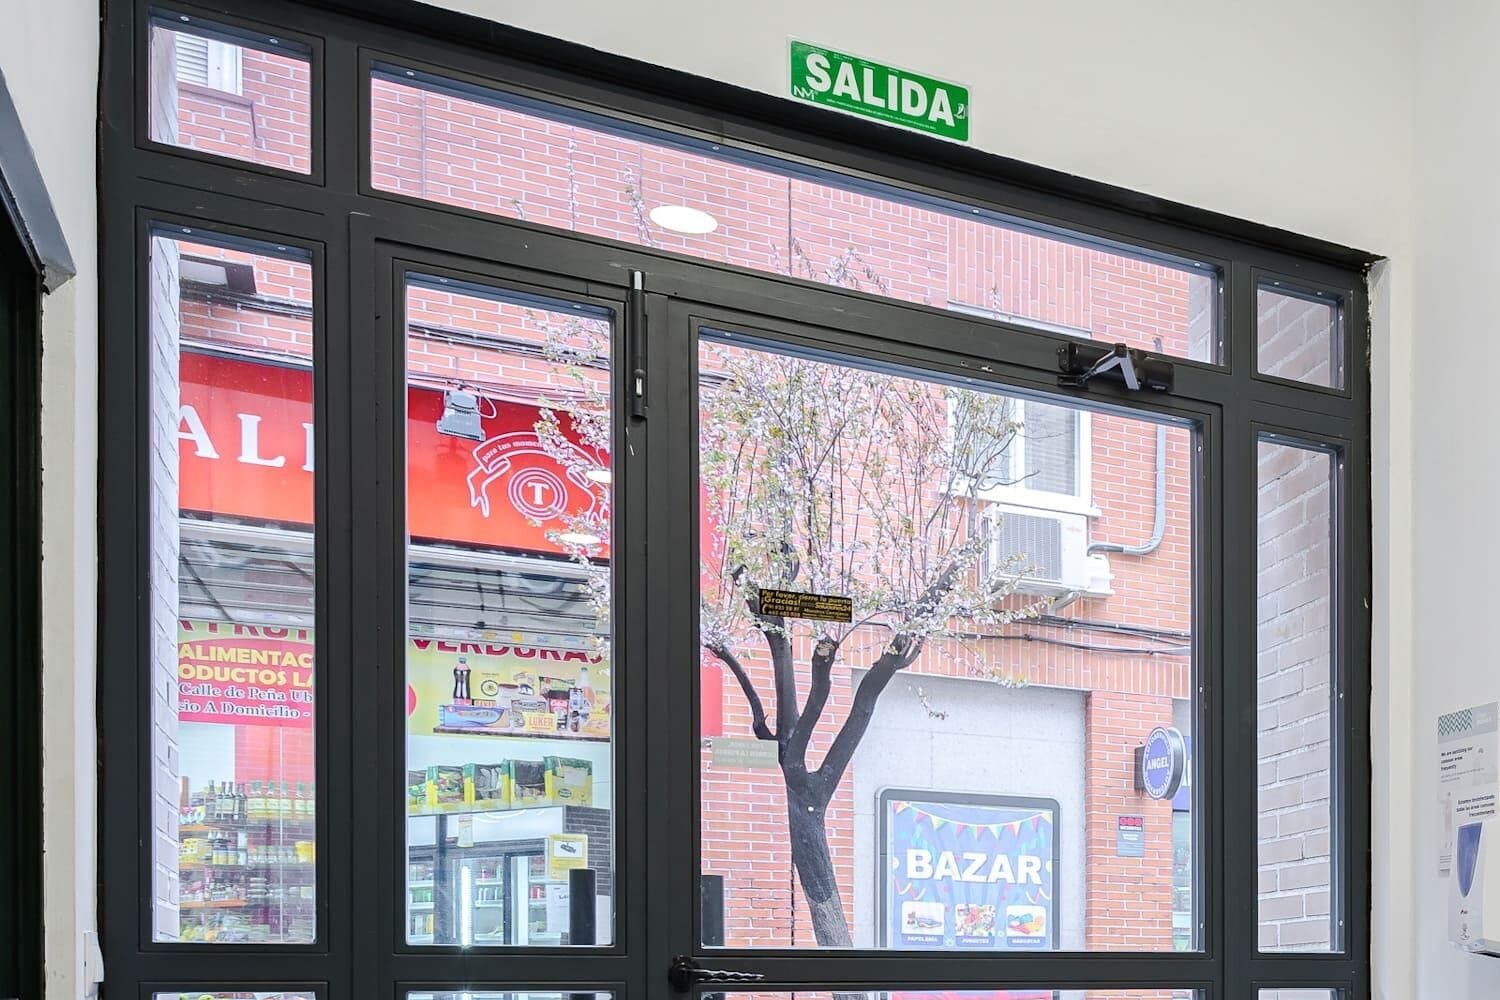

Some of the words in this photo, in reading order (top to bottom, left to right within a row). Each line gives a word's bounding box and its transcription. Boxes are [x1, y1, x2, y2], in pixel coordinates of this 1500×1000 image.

[805, 52, 956, 127] SALIDA
[527, 481, 550, 505] T
[179, 682, 222, 697] Calle
[225, 685, 244, 699] de
[250, 687, 286, 701] Peña
[203, 701, 218, 713] A
[222, 702, 300, 718] Domicilio
[1146, 756, 1169, 770] ANGEL
[906, 848, 1043, 885] BAZAR
